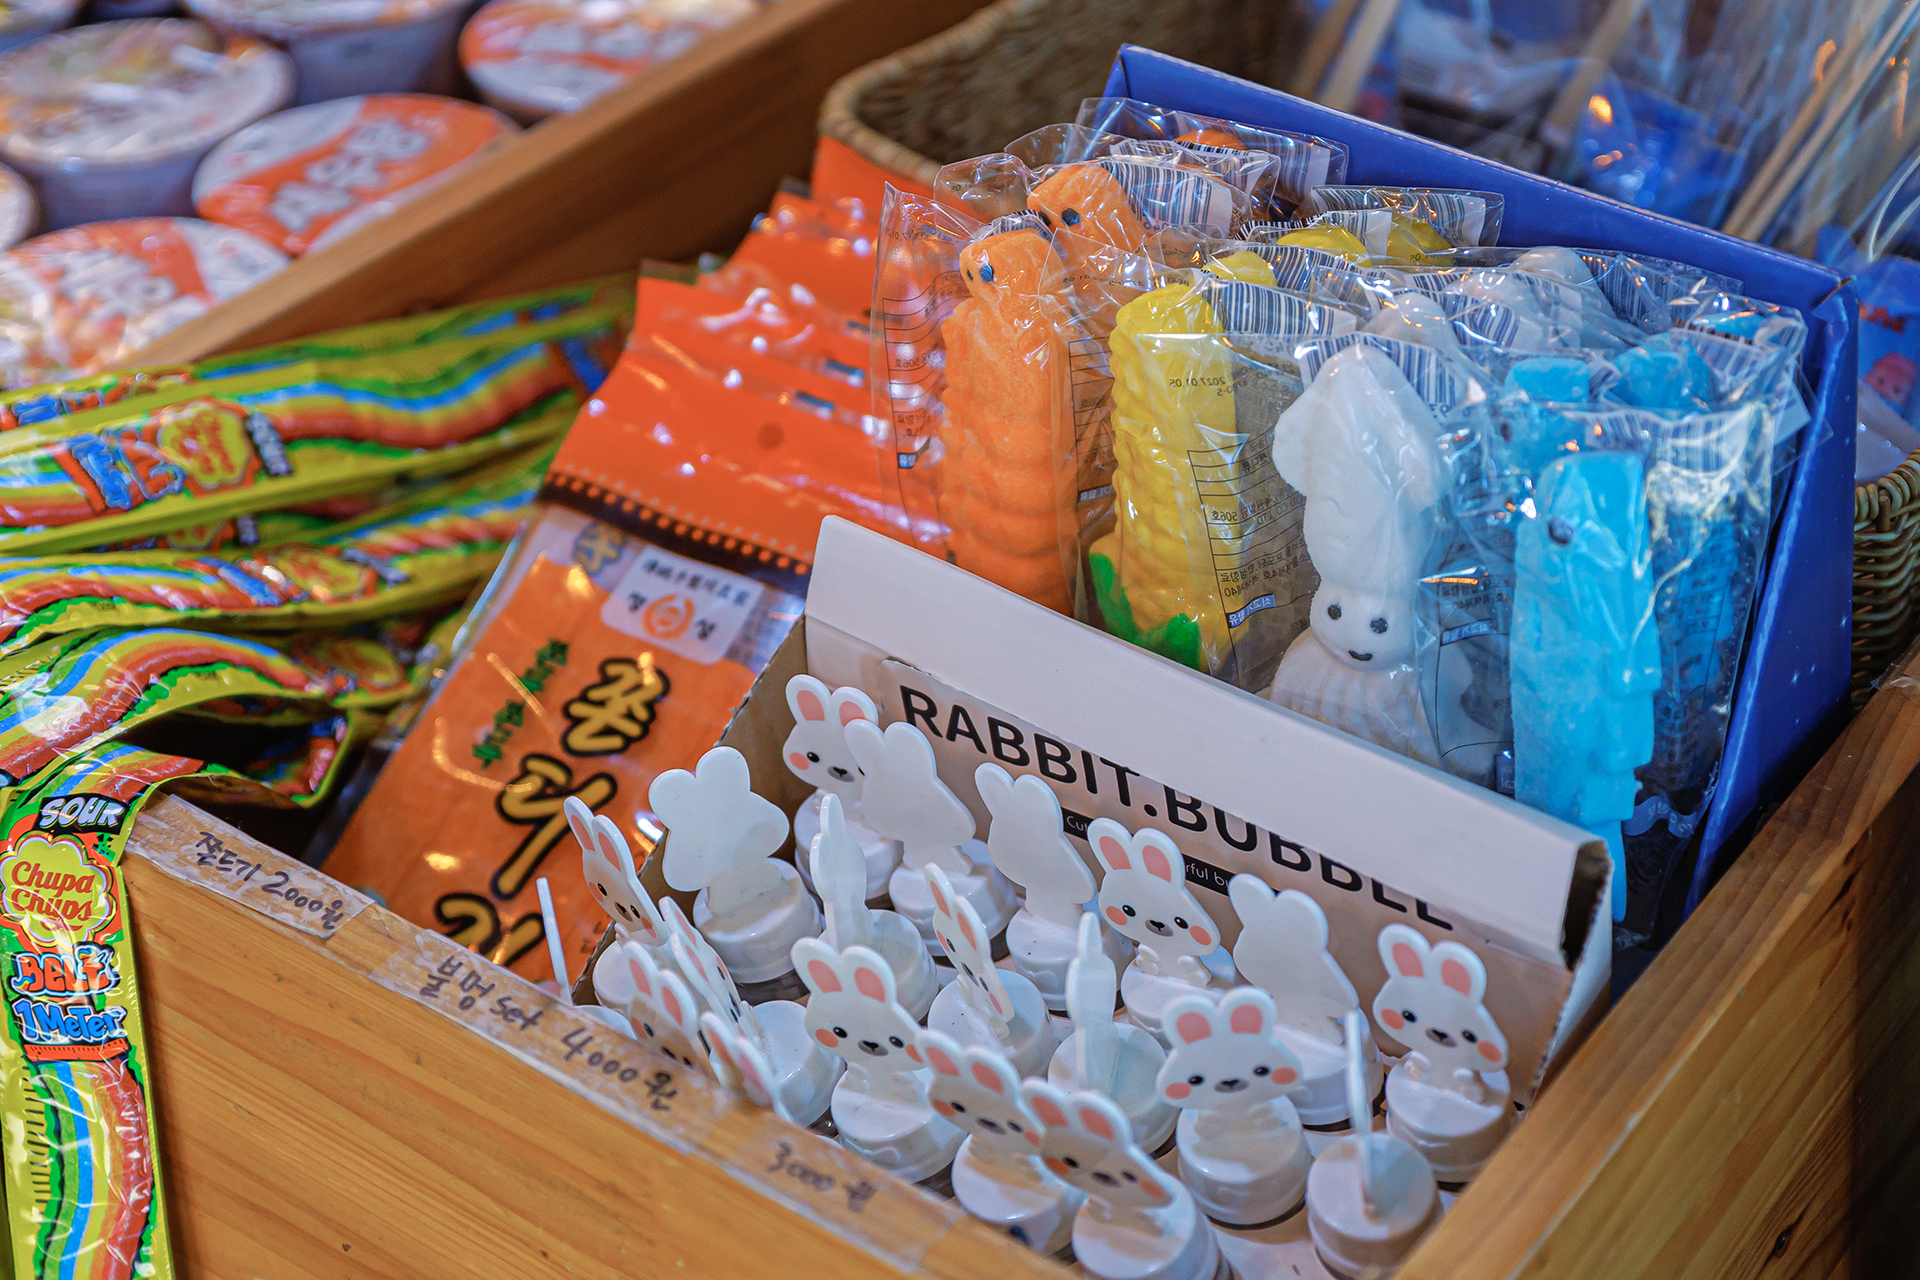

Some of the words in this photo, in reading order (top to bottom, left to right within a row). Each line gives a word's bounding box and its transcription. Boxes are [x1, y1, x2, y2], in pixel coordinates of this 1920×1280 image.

[38, 796, 125, 829] SOUR
[11, 860, 96, 898] Chupa
[11, 887, 94, 931] Chups
